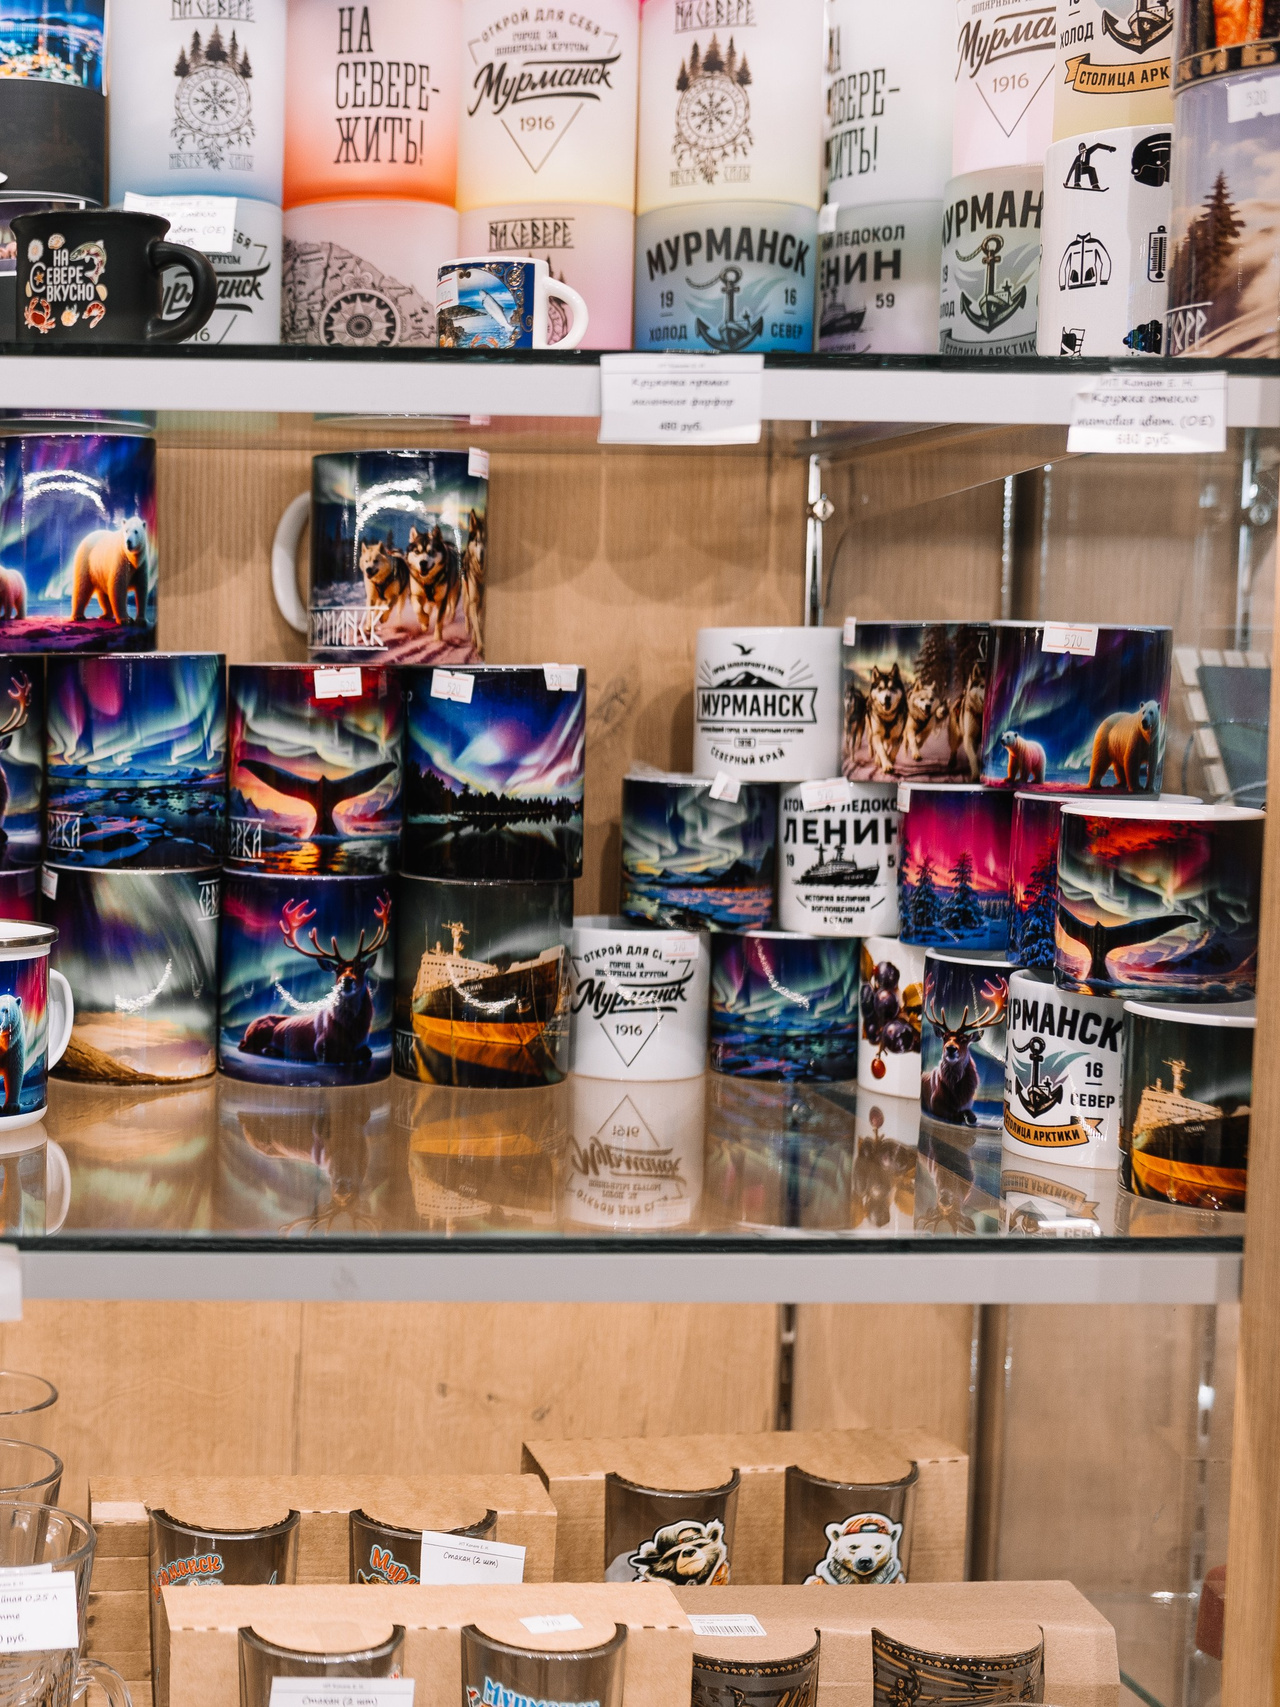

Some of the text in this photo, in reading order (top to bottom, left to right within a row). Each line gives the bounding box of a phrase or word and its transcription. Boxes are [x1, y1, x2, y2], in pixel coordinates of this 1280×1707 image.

[336, 6, 374, 54] НА
[481, 7, 602, 44] ОТКРОЙ ДЛЯ СЕБЯ
[1060, 22, 1094, 50] ХОЛОД
[336, 61, 440, 112] СЕВЕРЕ-
[467, 54, 619, 117] Мурманск
[992, 73, 1030, 94] 1916
[1079, 69, 1136, 88] СТОЛИЦА
[520, 116, 555, 132] 1916
[333, 116, 426, 166] ЖИТЬ!
[837, 224, 906, 247] ЛЕДОКОЛ
[53, 250, 69, 267] НА
[646, 226, 812, 281] МУРМАНСК
[46, 283, 95, 302] ВКУСНО
[659, 287, 797, 308] 19 16
[874, 292, 896, 309] 59
[648, 321, 804, 343] ХОЛОД СЕВЕР
[701, 693, 805, 717] МУРМАНСК
[710, 746, 785, 766] СЕВЕРНЫЙ КРАЙ
[786, 853, 795, 867] 19
[583, 945, 650, 964] ОТКРОЙ ДЛЯ
[615, 1025, 643, 1036] 1916
[1085, 1061, 1104, 1079] 16
[1070, 1093, 1116, 1110] СЕВЕР
[1033, 1128, 1081, 1143] АРКТИКИ
[443, 1551, 471, 1562] Стакан
[483, 1558, 499, 1569] шт)
[6, 1633, 27, 1645] руб.
